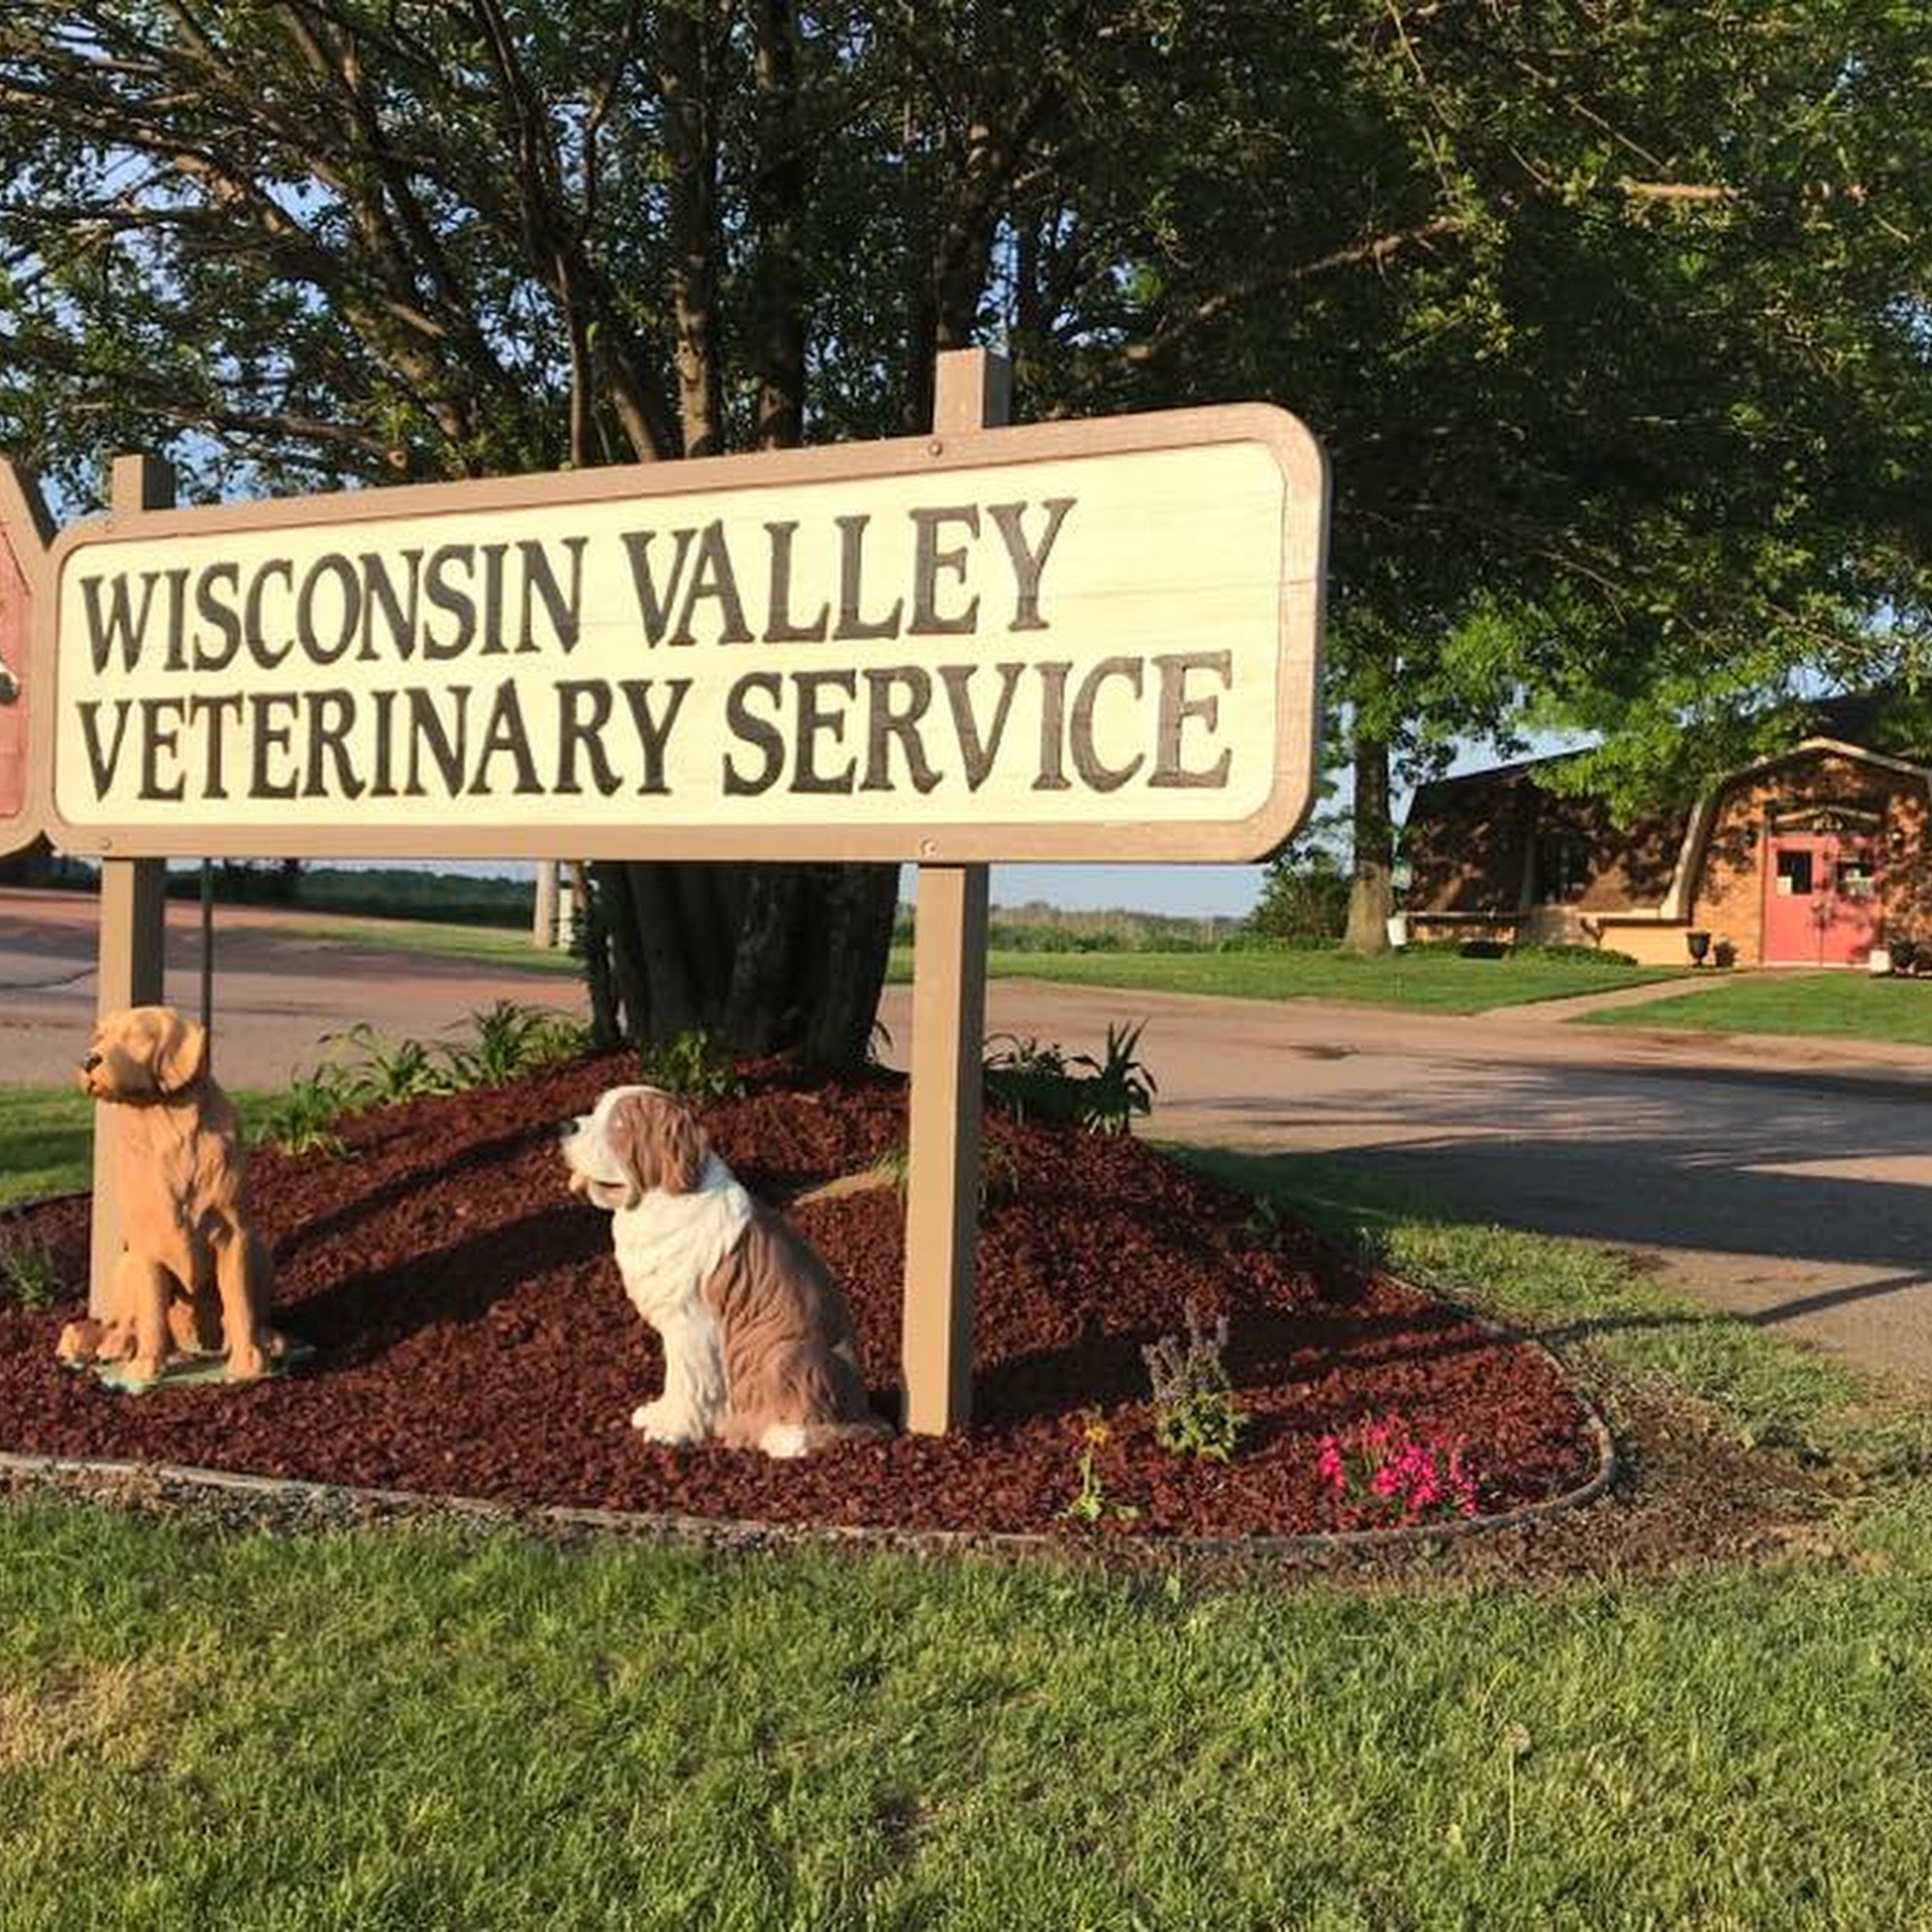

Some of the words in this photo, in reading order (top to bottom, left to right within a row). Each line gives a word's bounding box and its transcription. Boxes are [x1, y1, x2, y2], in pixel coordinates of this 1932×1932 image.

[79, 536, 588, 675] WISCONSIN
[620, 497, 1077, 649] VALLEY
[76, 677, 693, 802] VETERINARY
[723, 649, 1233, 797] SERVICE
